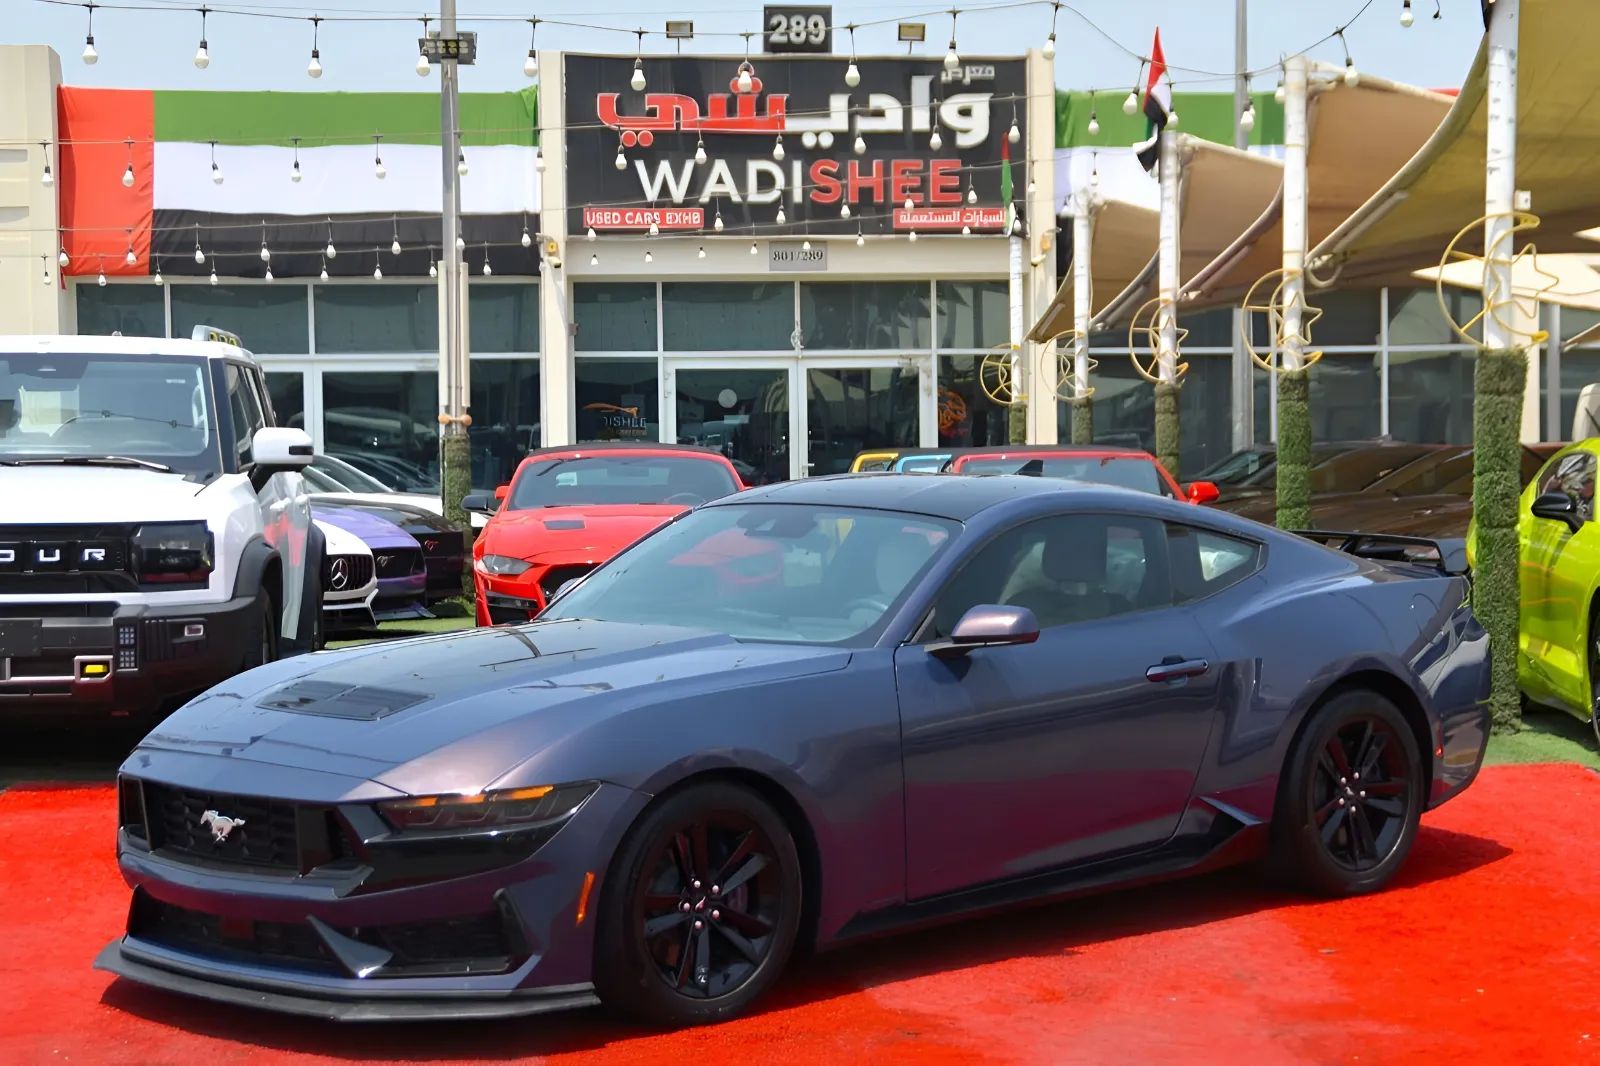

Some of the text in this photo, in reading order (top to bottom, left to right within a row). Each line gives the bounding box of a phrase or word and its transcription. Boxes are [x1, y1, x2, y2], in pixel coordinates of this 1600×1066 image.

[769, 14, 826, 45] 289
[941, 65, 995, 85] معرض
[586, 211, 701, 225] USED CARS EXHB
[899, 210, 961, 224] المستعملة
